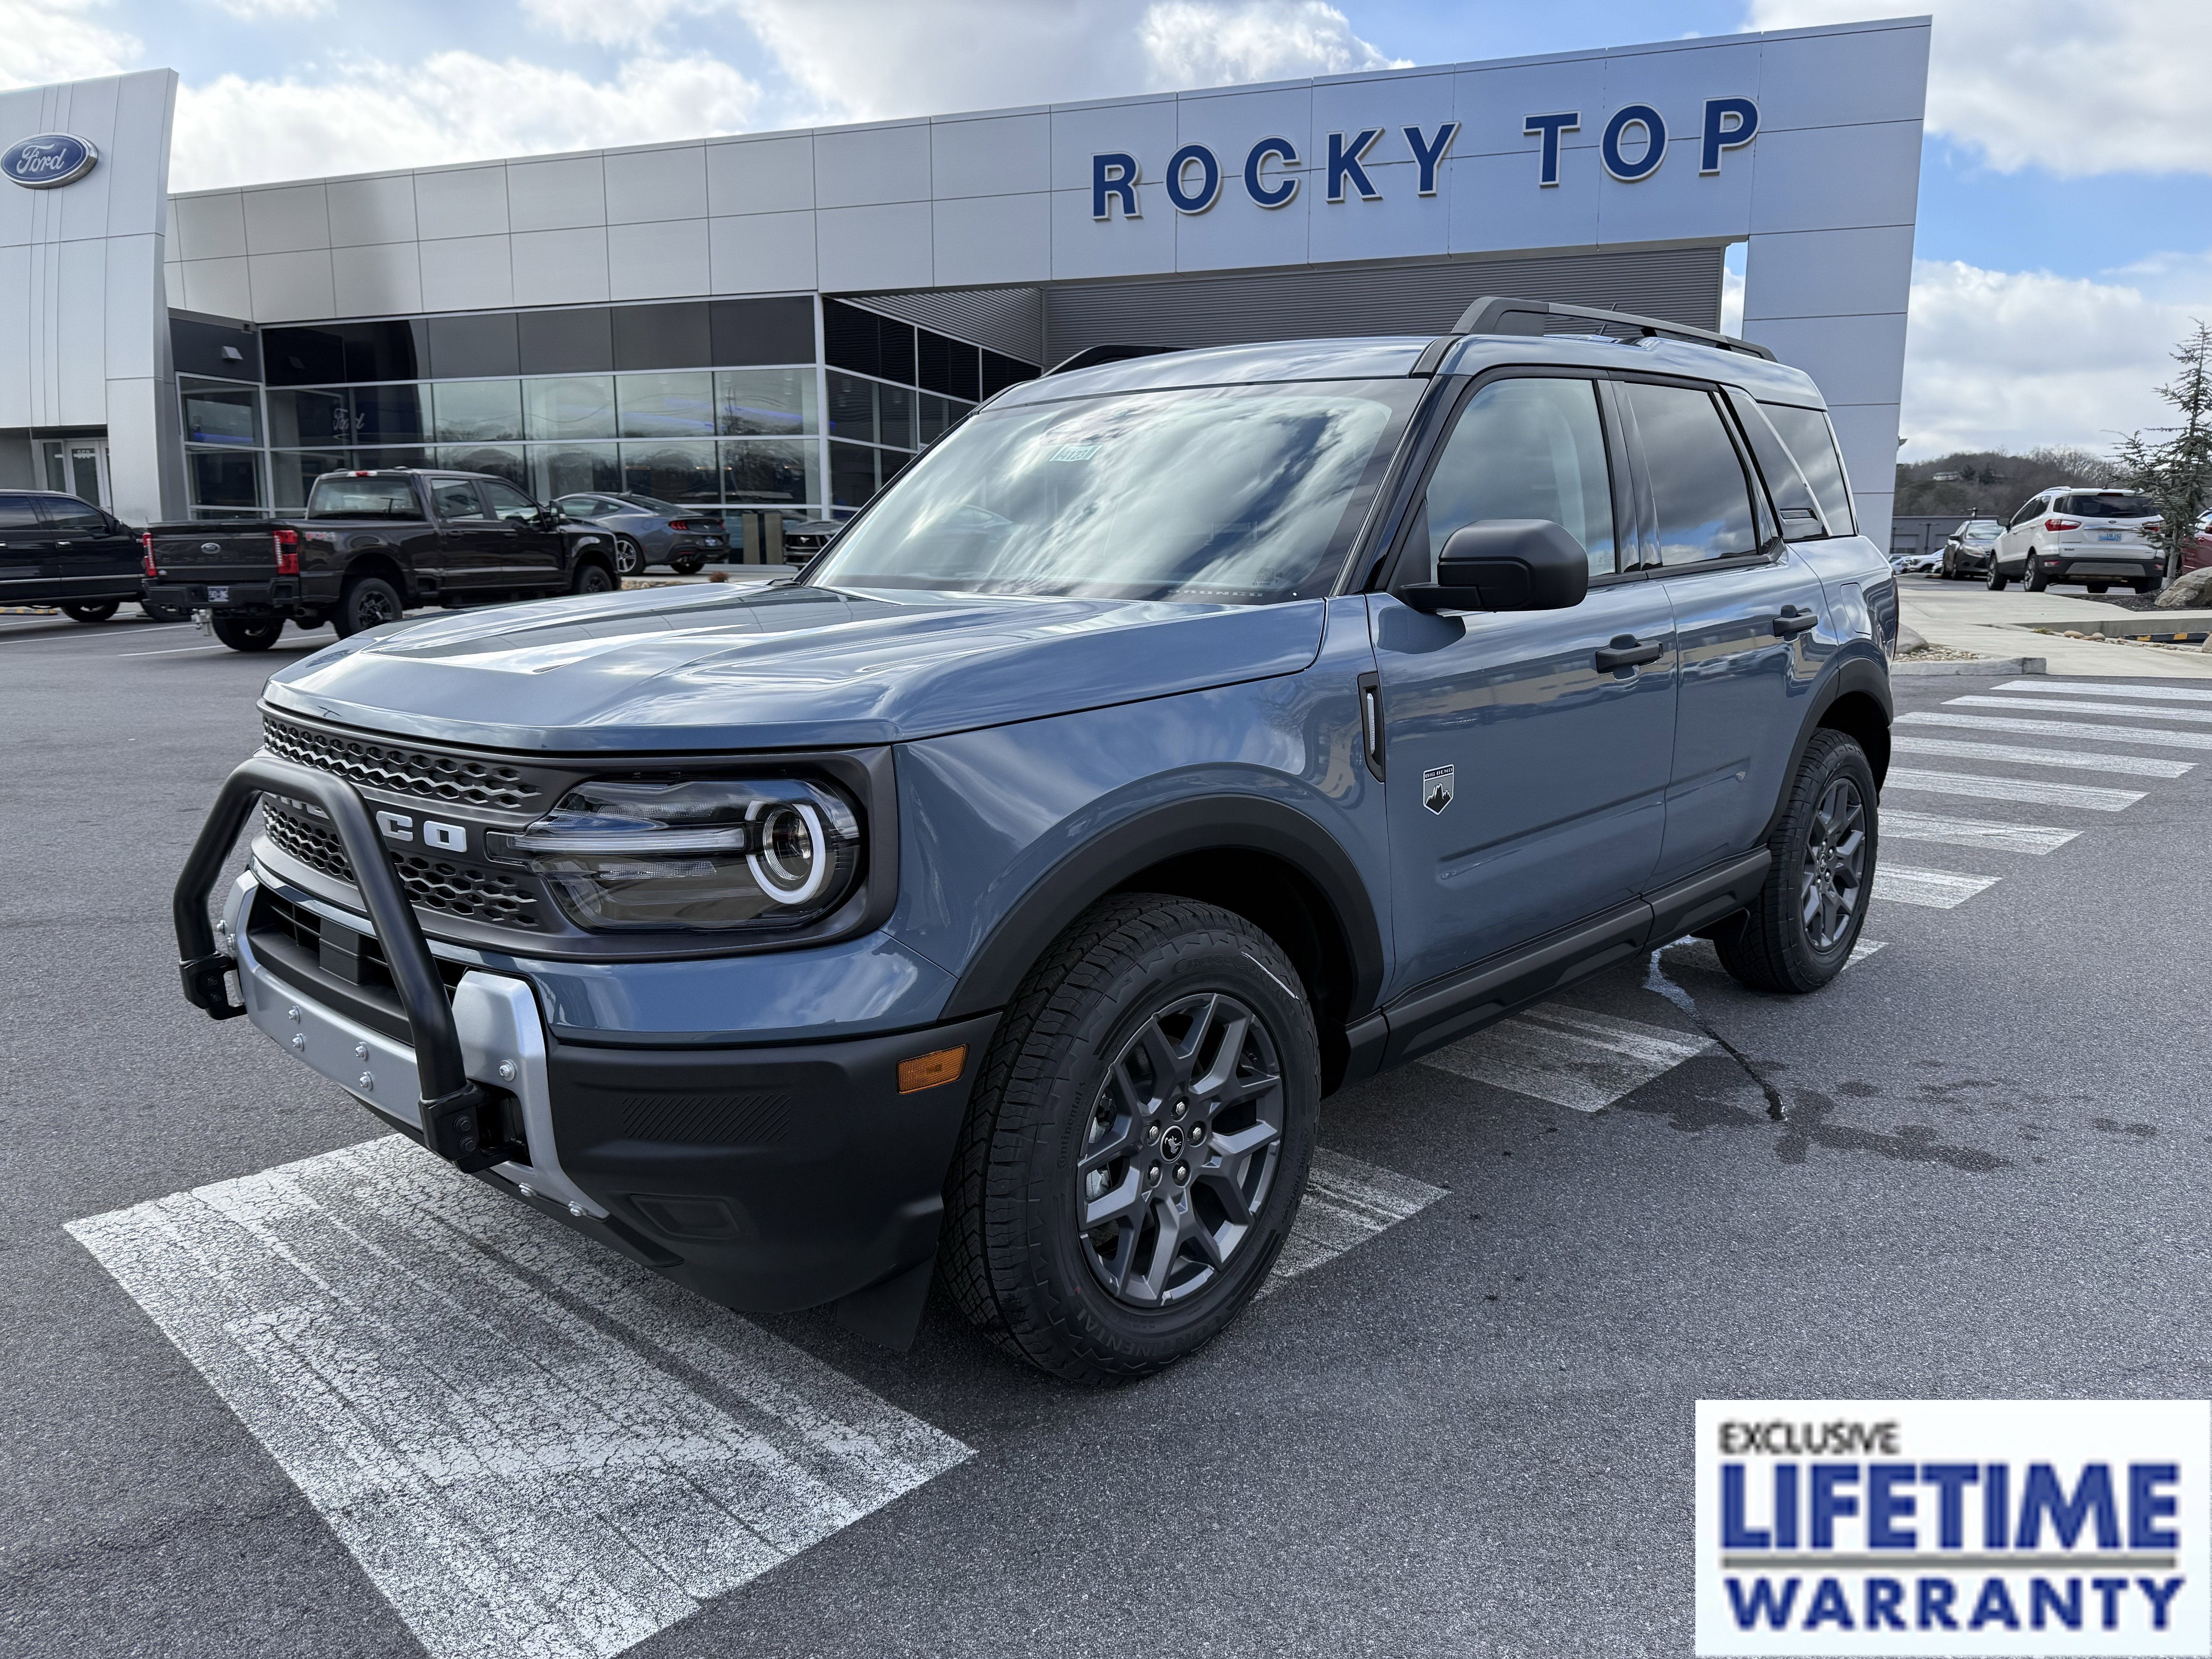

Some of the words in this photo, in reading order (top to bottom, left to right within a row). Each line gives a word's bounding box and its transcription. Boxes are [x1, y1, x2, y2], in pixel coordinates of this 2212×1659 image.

[16, 144, 67, 173] Ford
[1091, 120, 1461, 222] ROCKY
[1522, 96, 1762, 187] TOP
[333, 408, 365, 430] Fod
[1058, 1090, 1083, 1170] Continental
[1075, 1300, 1222, 1357] CONTINENTAL
